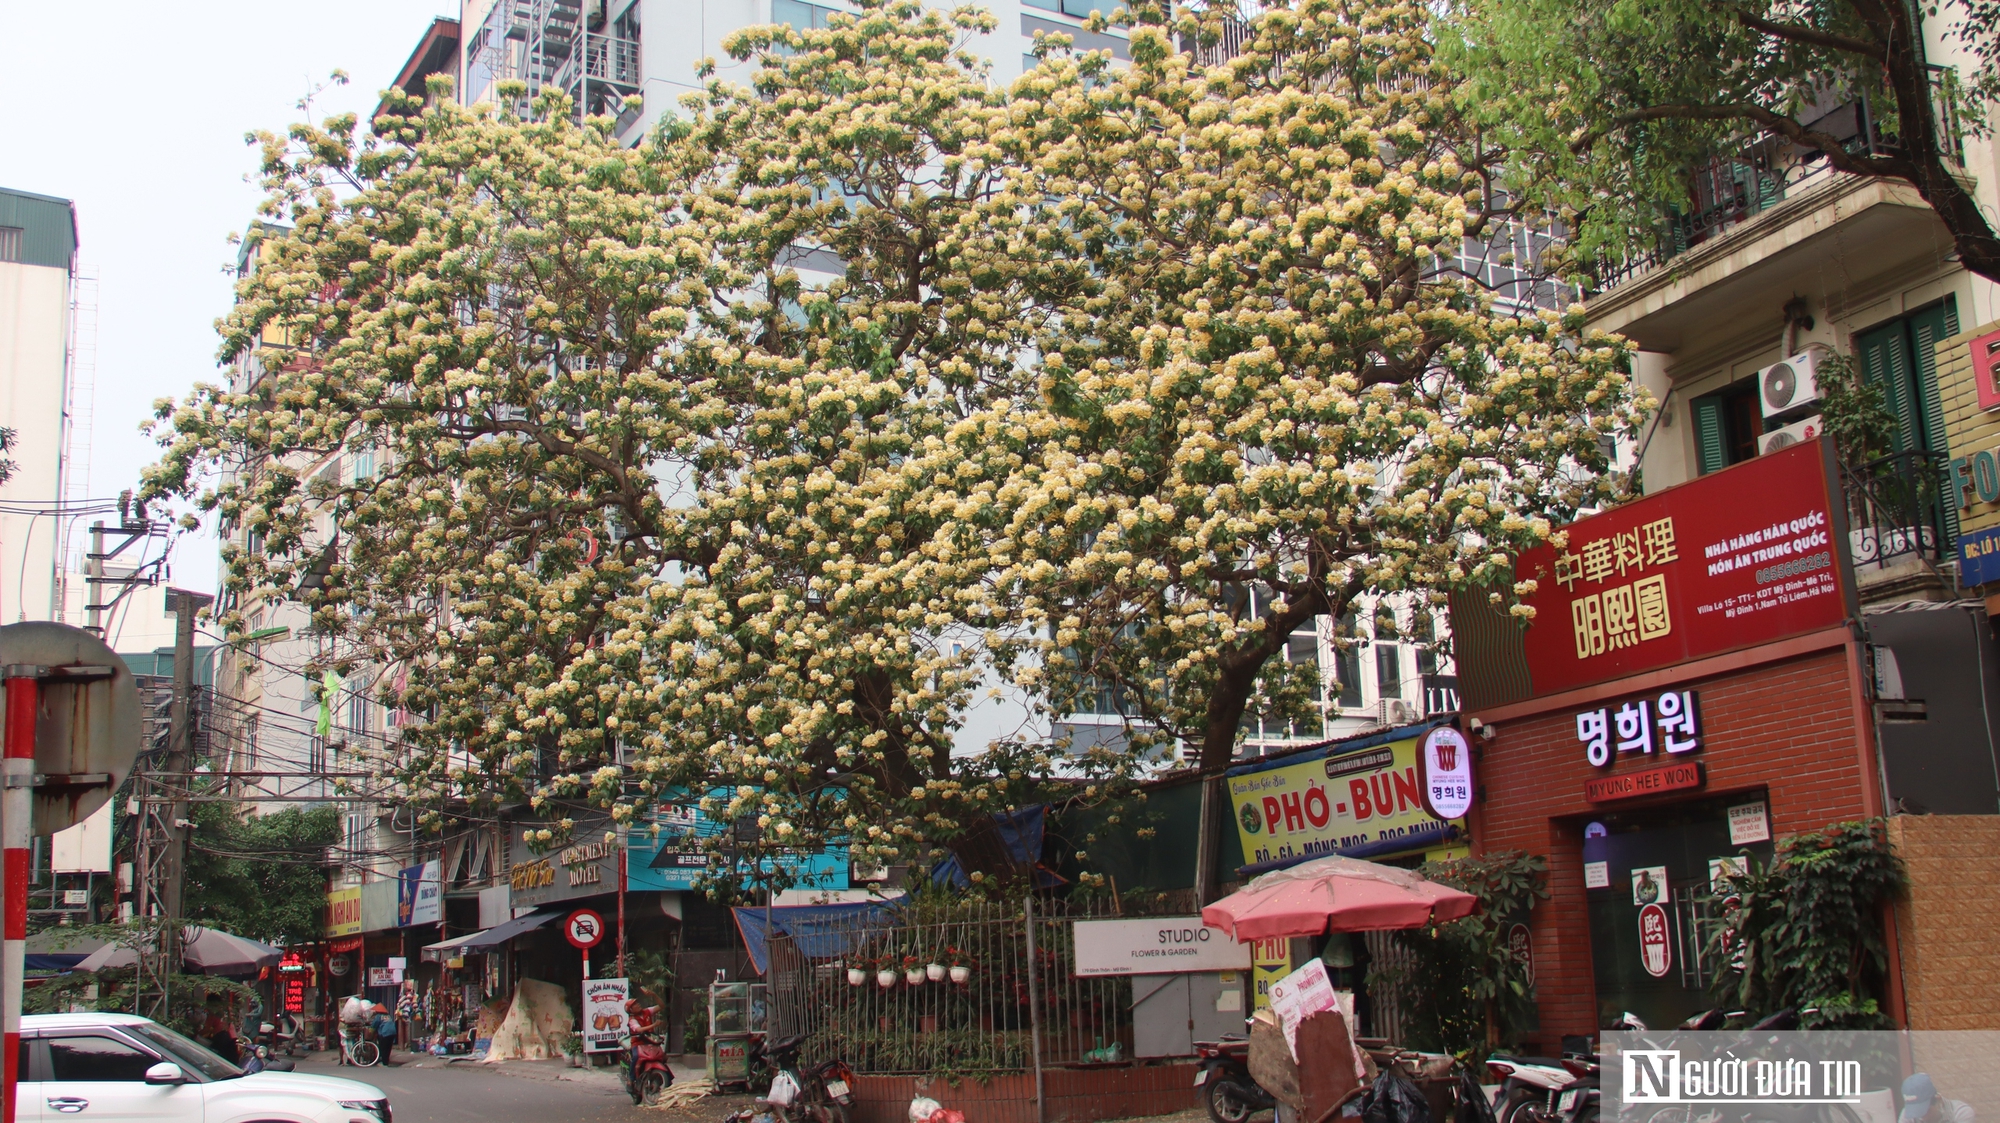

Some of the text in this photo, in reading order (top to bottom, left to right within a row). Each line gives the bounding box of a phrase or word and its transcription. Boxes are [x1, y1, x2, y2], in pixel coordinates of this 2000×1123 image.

[1950, 450, 2000, 509] FO
[1705, 510, 1824, 558] NHÀ HÀNG HÀN QUỐC
[1981, 535, 1993, 555] LÔ
[1554, 517, 1679, 592] 中華料理
[1708, 559, 1733, 576] MÓN
[1752, 542, 1792, 563] TRUNG
[1793, 529, 1827, 554] QUỐC
[1756, 551, 1831, 584] 0855668282
[1697, 605, 1713, 615] Villa
[1773, 585, 1784, 596] Mỹ
[1725, 608, 1735, 618] Mỹ
[1736, 604, 1753, 615] Đình
[1821, 583, 1834, 594] Nội
[1576, 690, 1697, 767] 명희원
[1432, 786, 1467, 800] 명희원
[1589, 768, 1695, 798] MYUNG HEE WON
[1262, 778, 1331, 836] PHỞ
[1348, 767, 1421, 821] BÚN
[560, 842, 610, 866] APARTMENT
[1158, 928, 1210, 944] STUDIO
[1131, 948, 1197, 958] FLOWER & GARDEN
[1297, 970, 1324, 992] PROMOTION
[719, 1047, 745, 1057] MÍA
